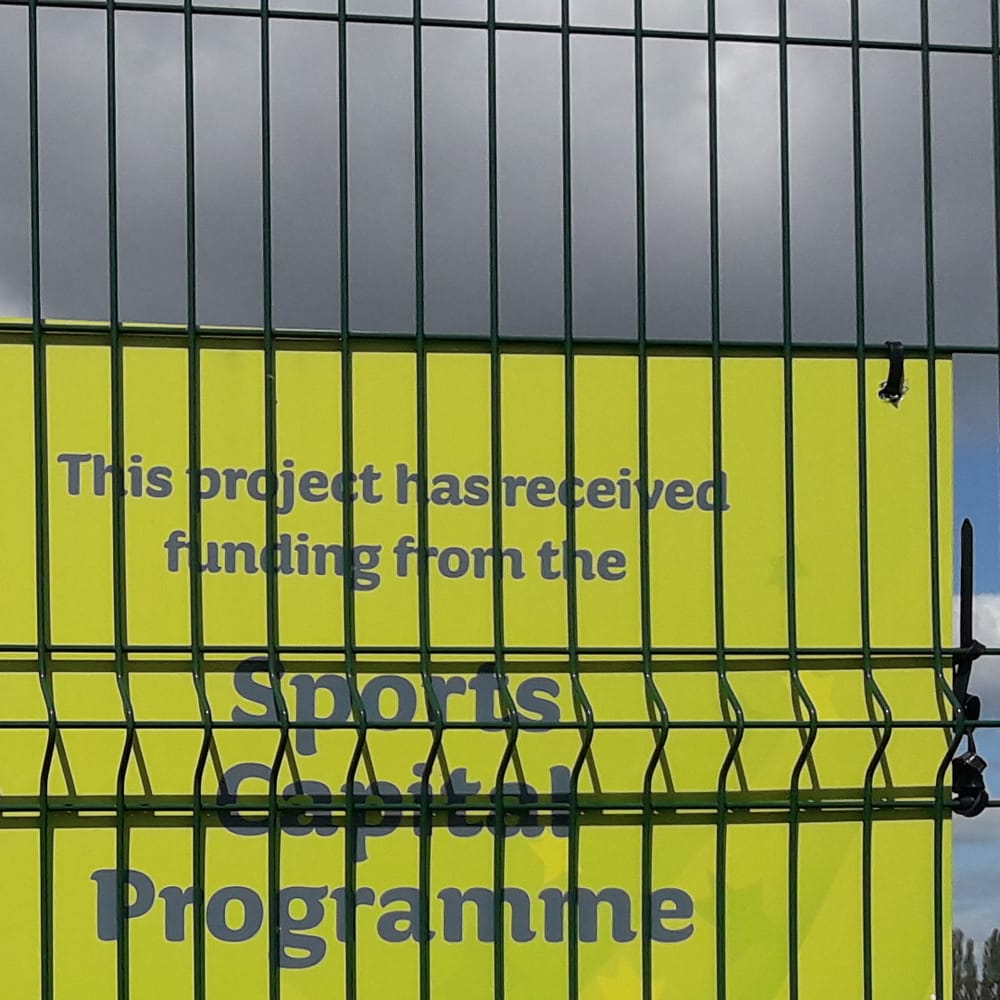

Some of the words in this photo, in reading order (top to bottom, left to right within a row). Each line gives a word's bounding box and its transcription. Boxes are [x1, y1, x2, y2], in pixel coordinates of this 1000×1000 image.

[57, 453, 172, 498] This
[187, 459, 383, 515] project
[396, 463, 490, 506] has
[500, 468, 730, 511] received
[164, 530, 382, 592] funding
[394, 535, 525, 580] from
[537, 539, 627, 582] the
[231, 656, 562, 756] Sports
[216, 762, 573, 863] Capital
[90, 868, 696, 970] Programme
